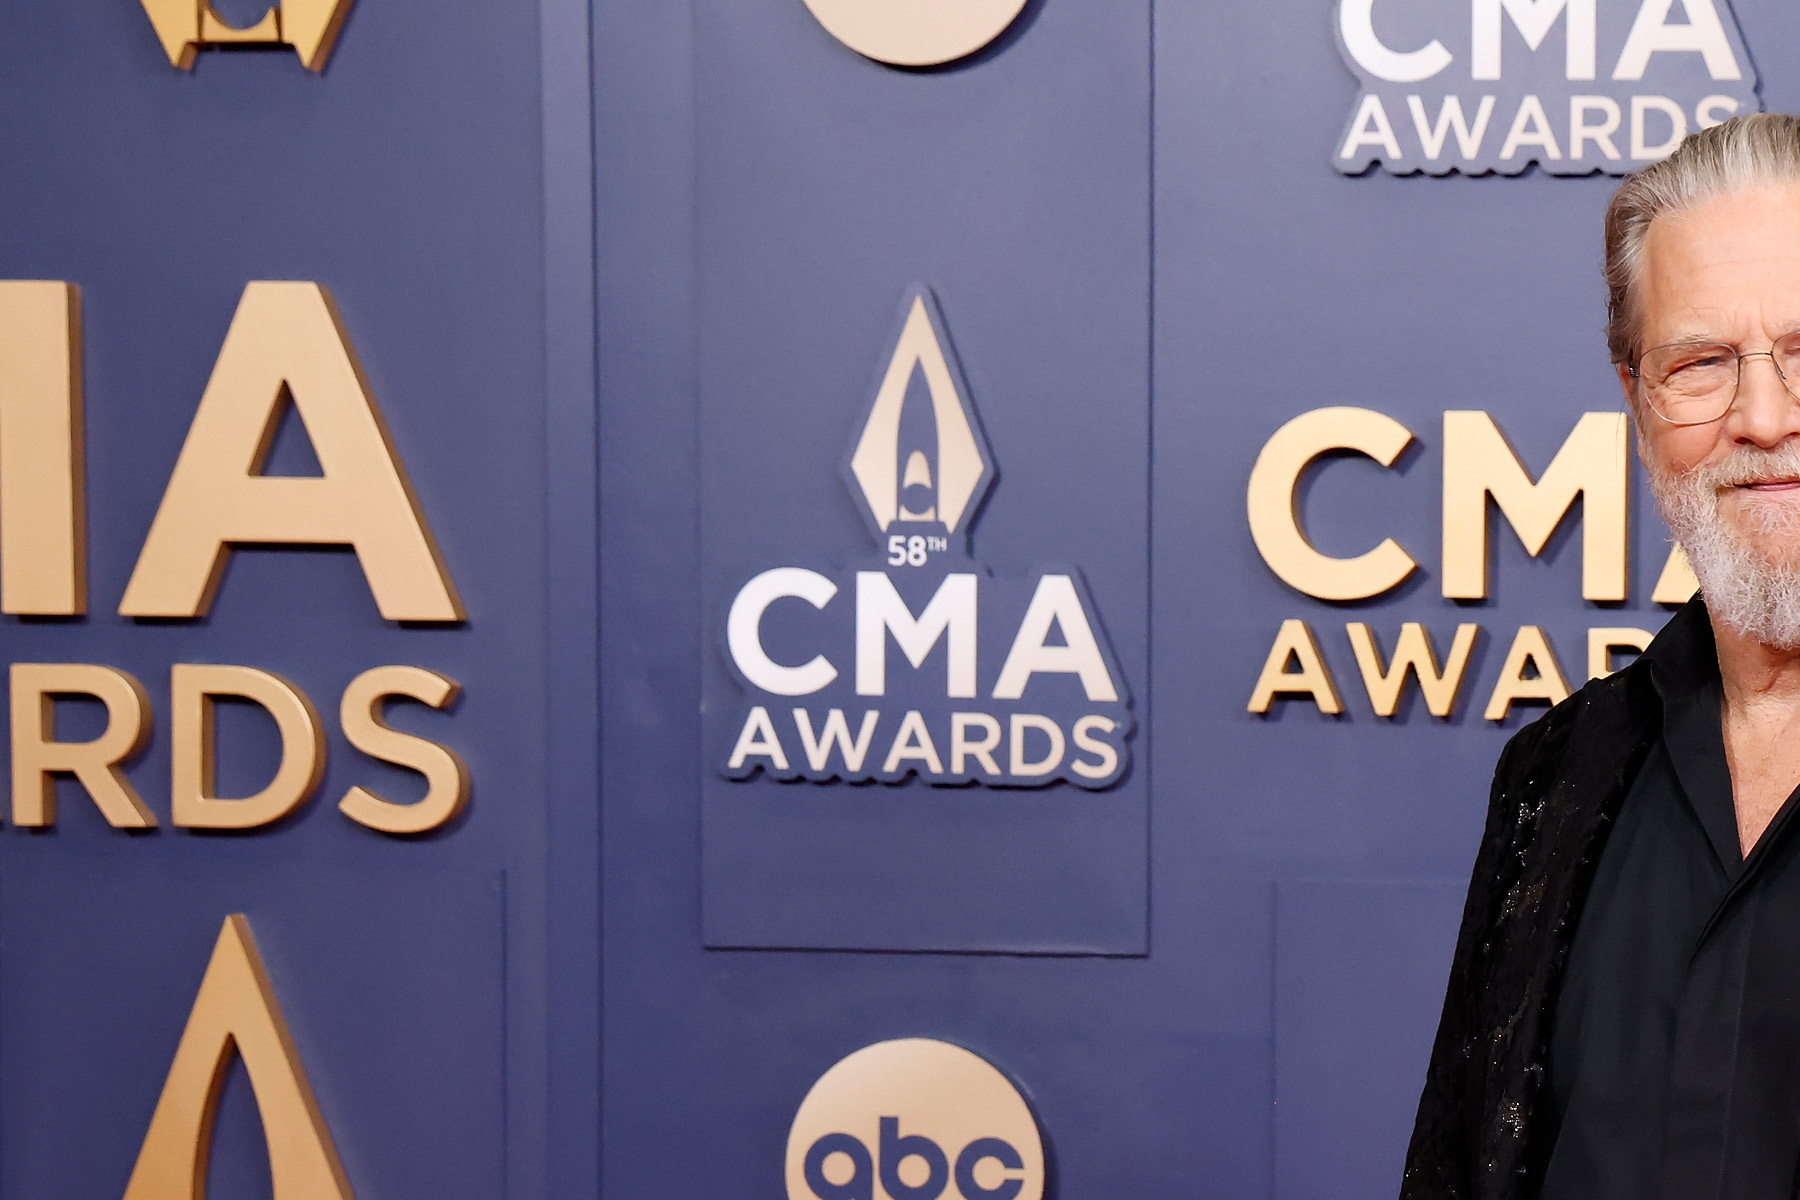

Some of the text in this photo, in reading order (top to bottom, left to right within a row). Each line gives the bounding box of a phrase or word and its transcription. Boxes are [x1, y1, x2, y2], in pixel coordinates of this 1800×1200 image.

[1340, 0, 1742, 82] CMA
[1248, 406, 1700, 604] CM
[727, 567, 1118, 700] CMA
[728, 706, 1119, 778] AWARDS
